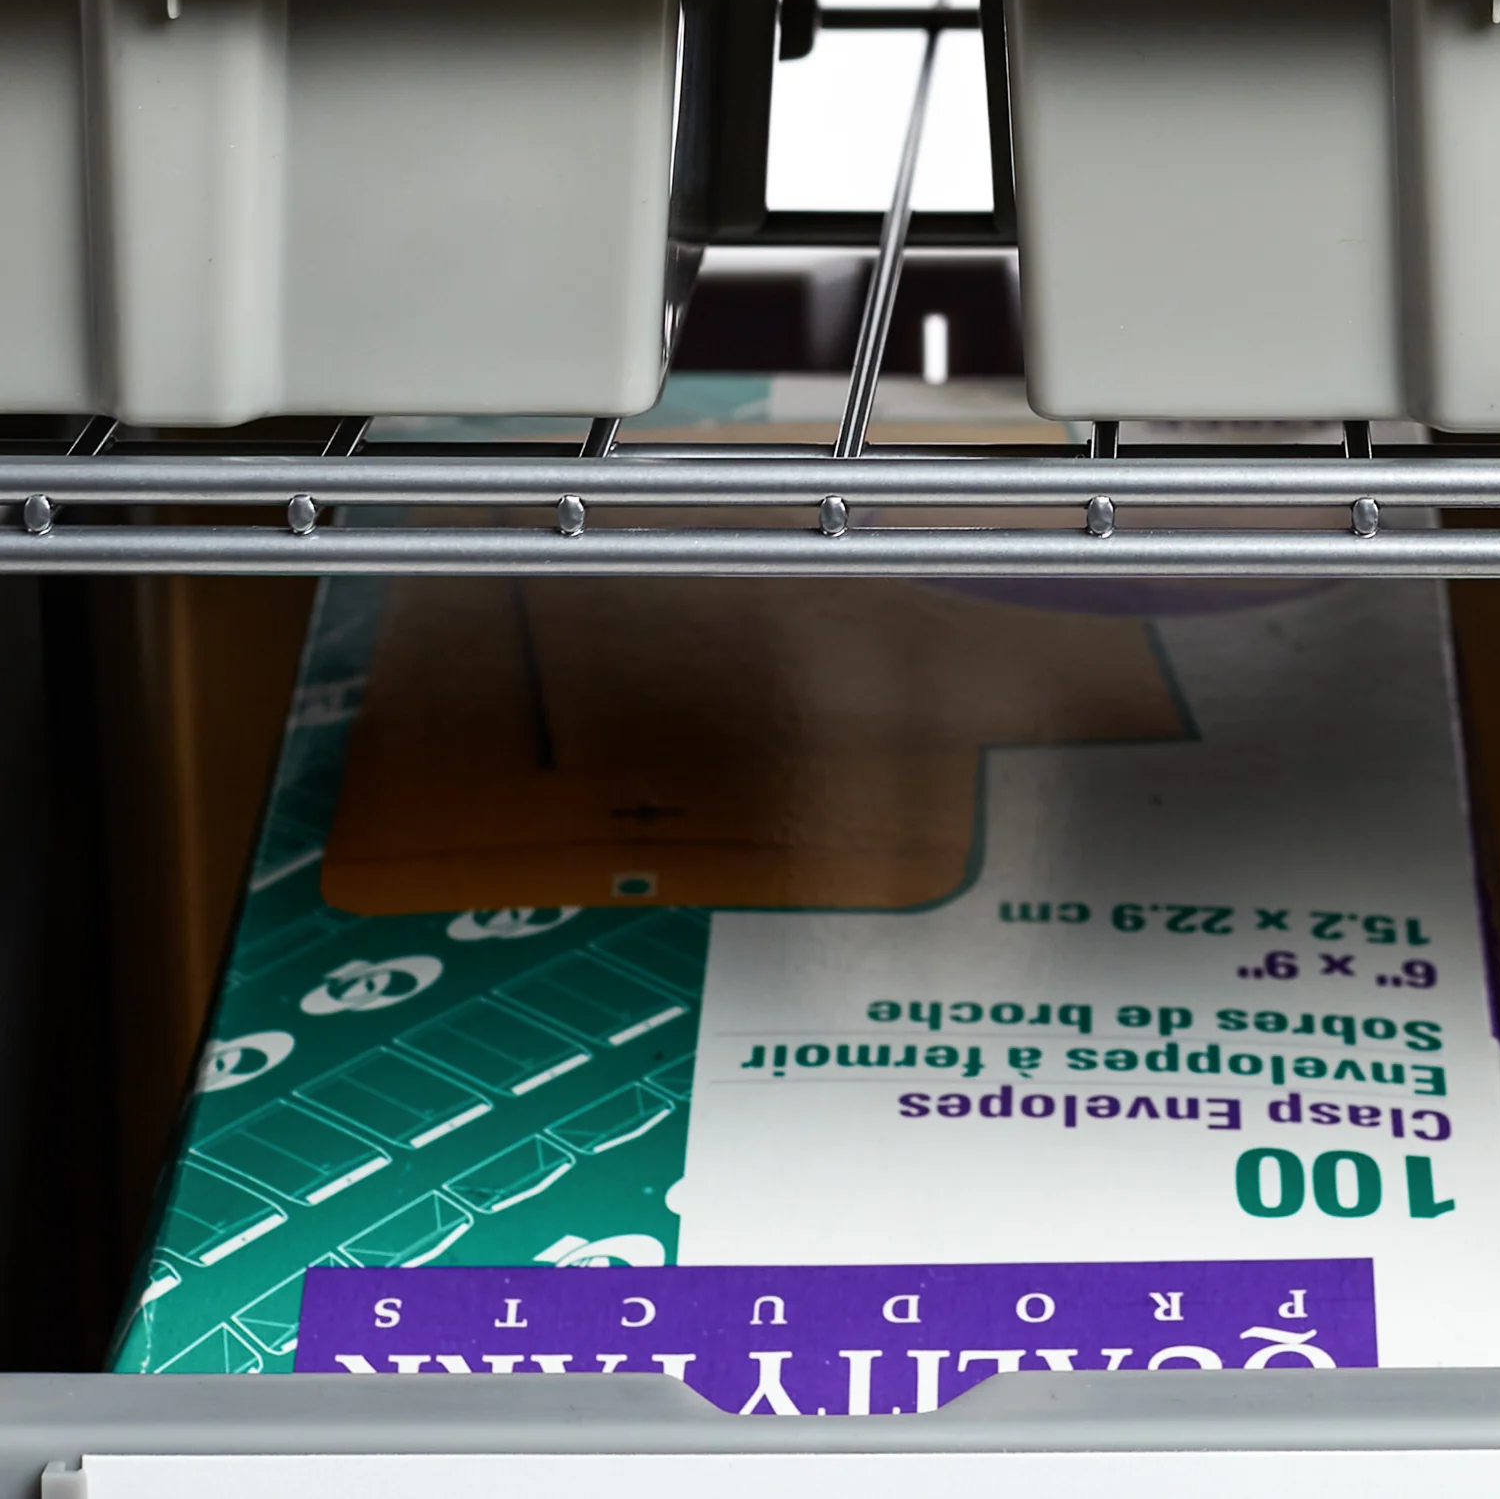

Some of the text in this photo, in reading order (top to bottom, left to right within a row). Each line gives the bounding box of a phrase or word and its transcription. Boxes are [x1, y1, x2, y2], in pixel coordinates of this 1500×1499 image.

[999, 902, 1431, 946] 15.2 x 22.9 cm
[1237, 951, 1438, 989] 6" x 9"
[867, 1000, 1443, 1051] Sobres de broche
[741, 1042, 1447, 1096] Enveloppes à fermoir
[898, 1085, 1452, 1141] Clasp Envelopes
[1236, 1147, 1455, 1218] 100
[373, 1290, 1308, 1328] PRODUCTS
